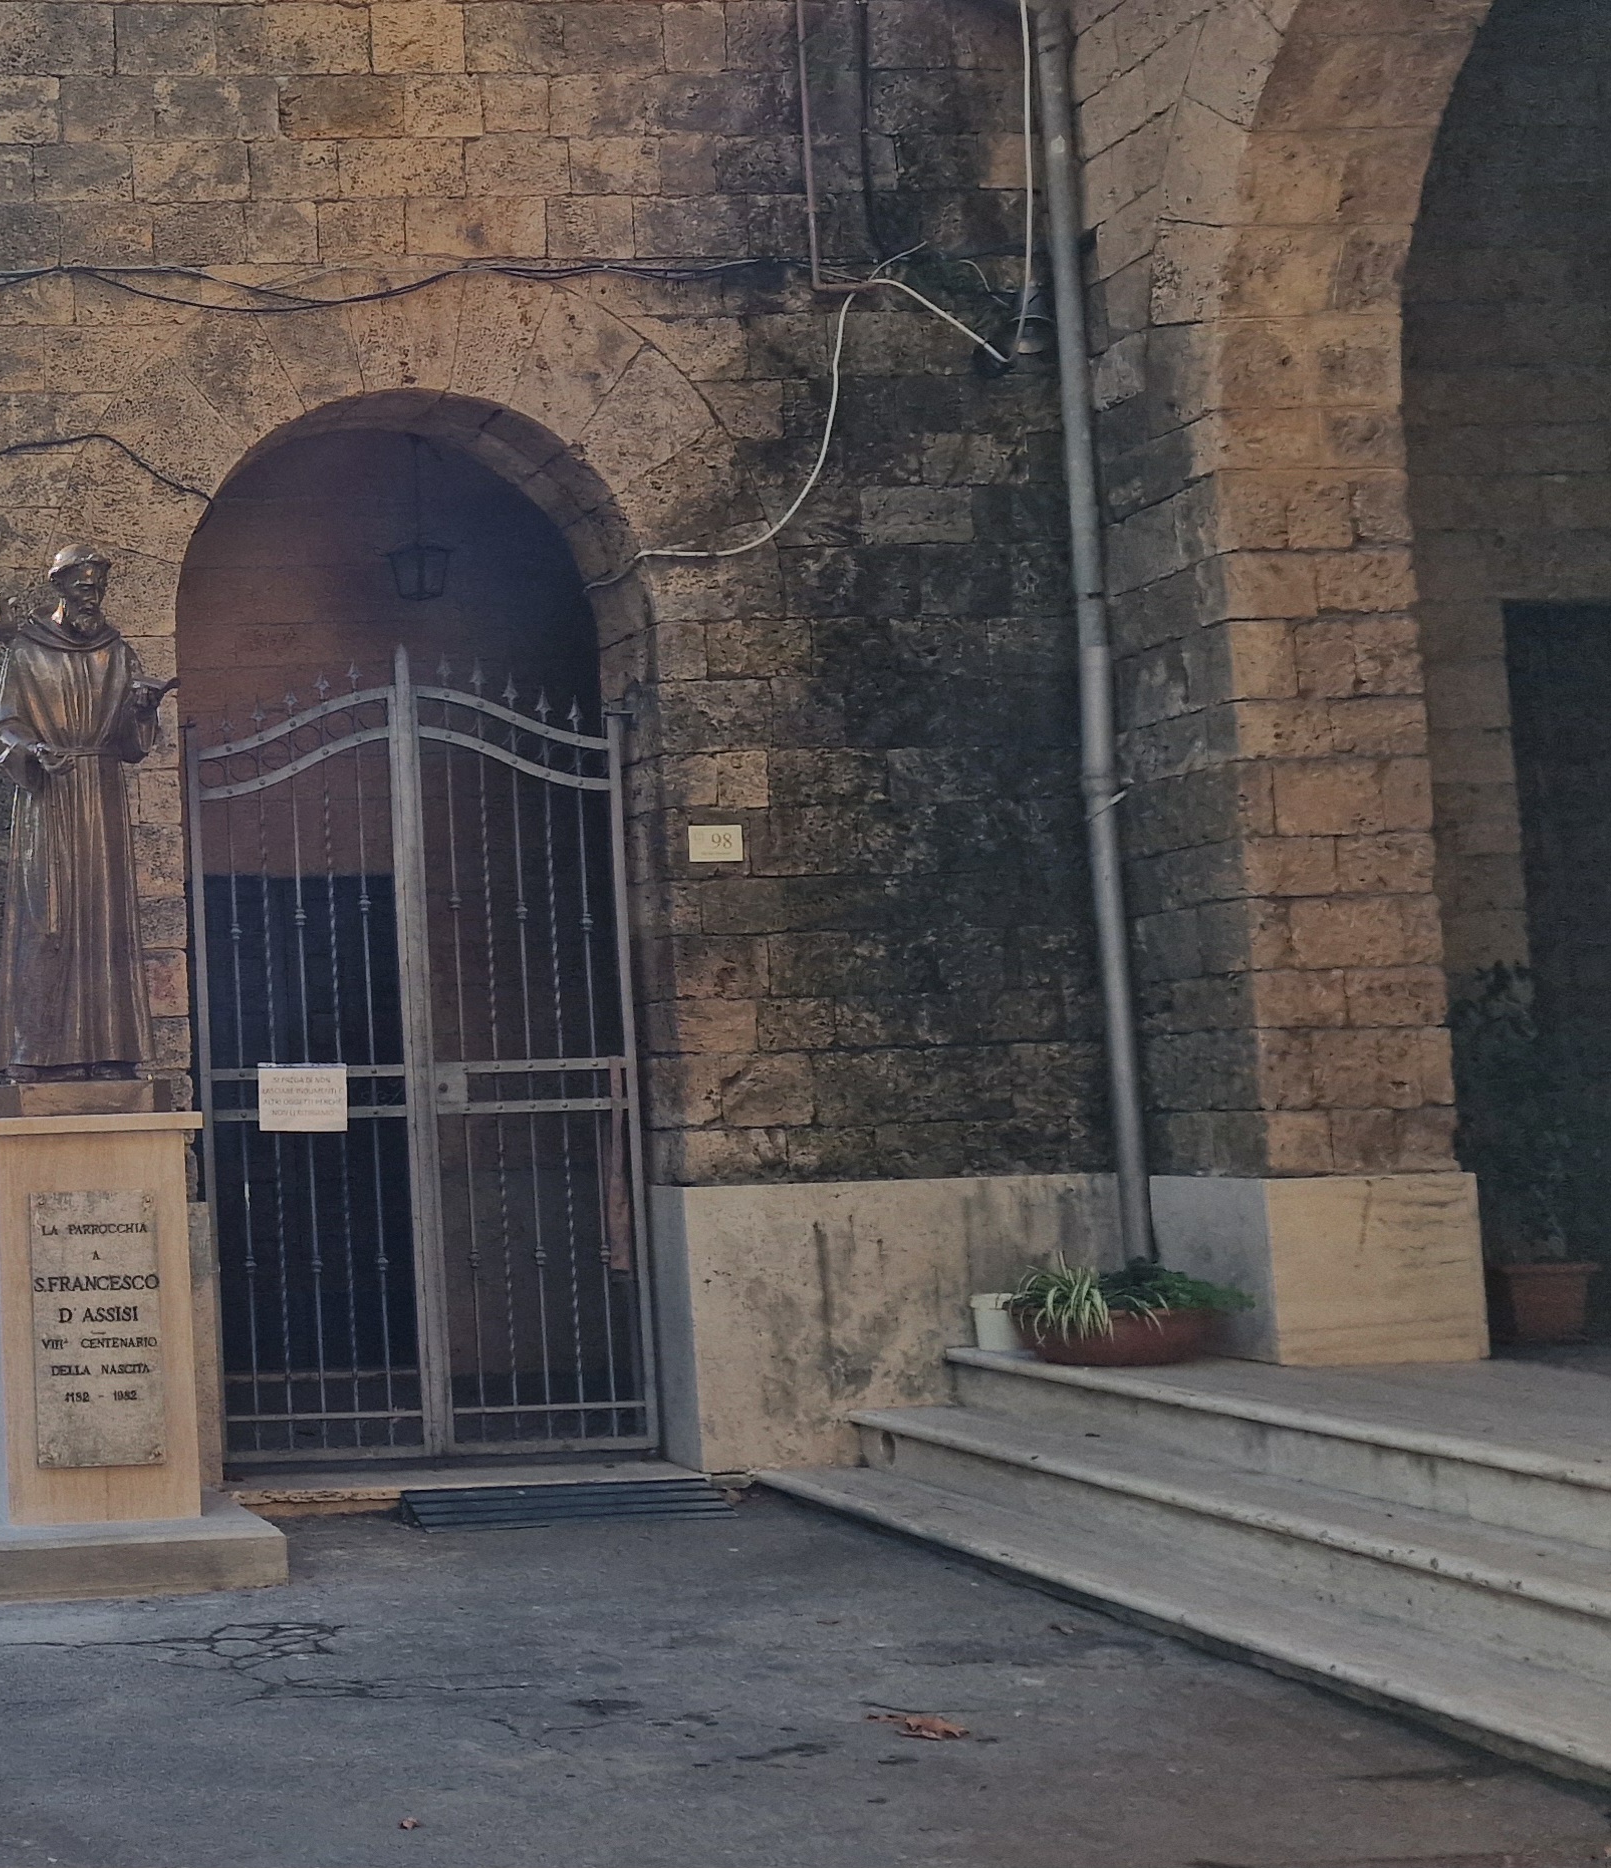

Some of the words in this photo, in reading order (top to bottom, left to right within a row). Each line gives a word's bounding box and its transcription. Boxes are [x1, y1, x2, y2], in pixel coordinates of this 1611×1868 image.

[711, 833, 732, 849] 98
[42, 1225, 58, 1236] LA
[68, 1223, 147, 1235] PARROCCHIA
[92, 1250, 101, 1260] A
[81, 1337, 157, 1349] CENTENARIO
[51, 1365, 91, 1376] DELLA
[101, 1362, 150, 1375] NASCITA
